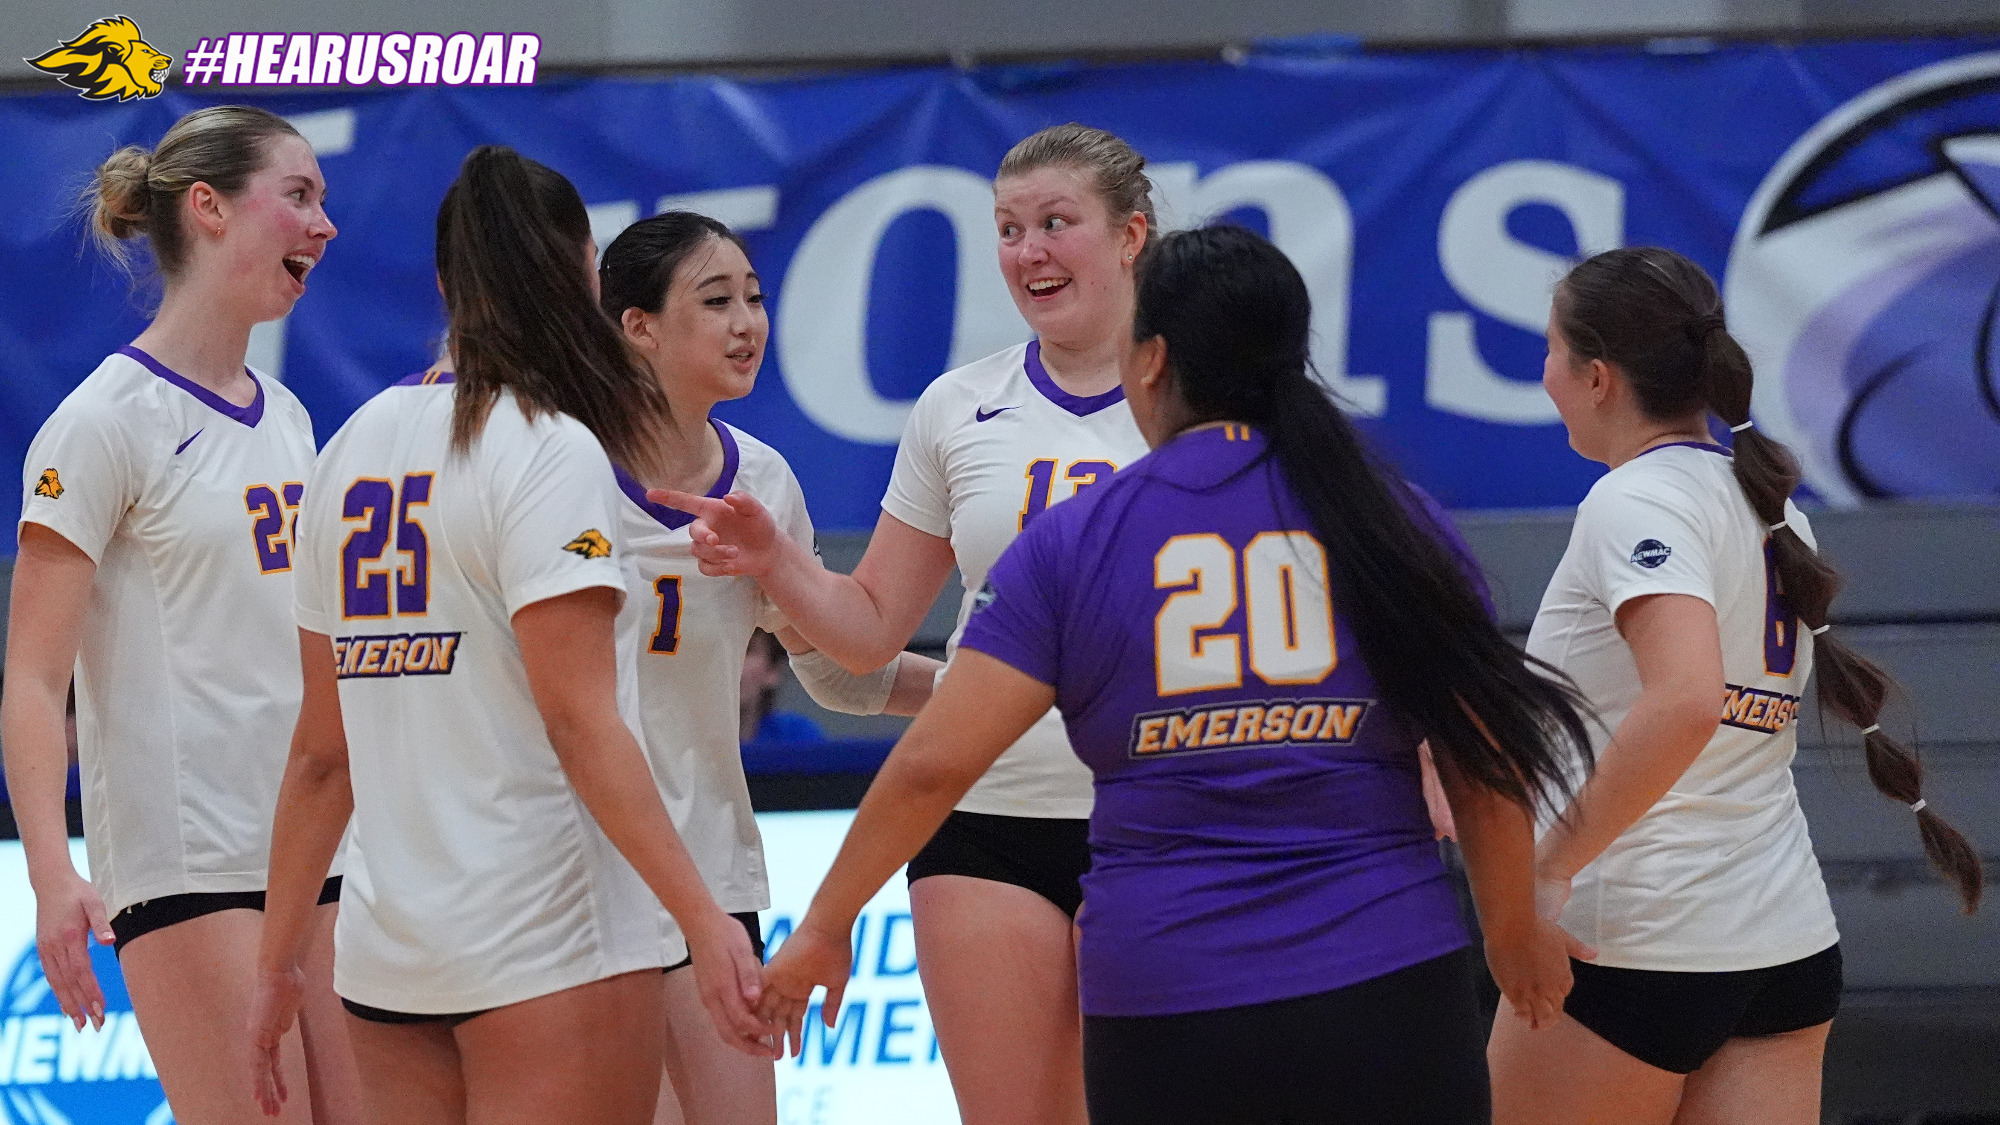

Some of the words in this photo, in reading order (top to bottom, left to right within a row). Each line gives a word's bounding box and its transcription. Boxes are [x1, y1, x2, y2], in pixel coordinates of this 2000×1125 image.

[340, 471, 436, 621] 25
[1631, 547, 1671, 563] NEWMAC
[648, 574, 683, 656] 1
[1154, 530, 1338, 697] 20
[1136, 705, 1361, 753] EMERSON
[798, 1001, 939, 1066] ME
